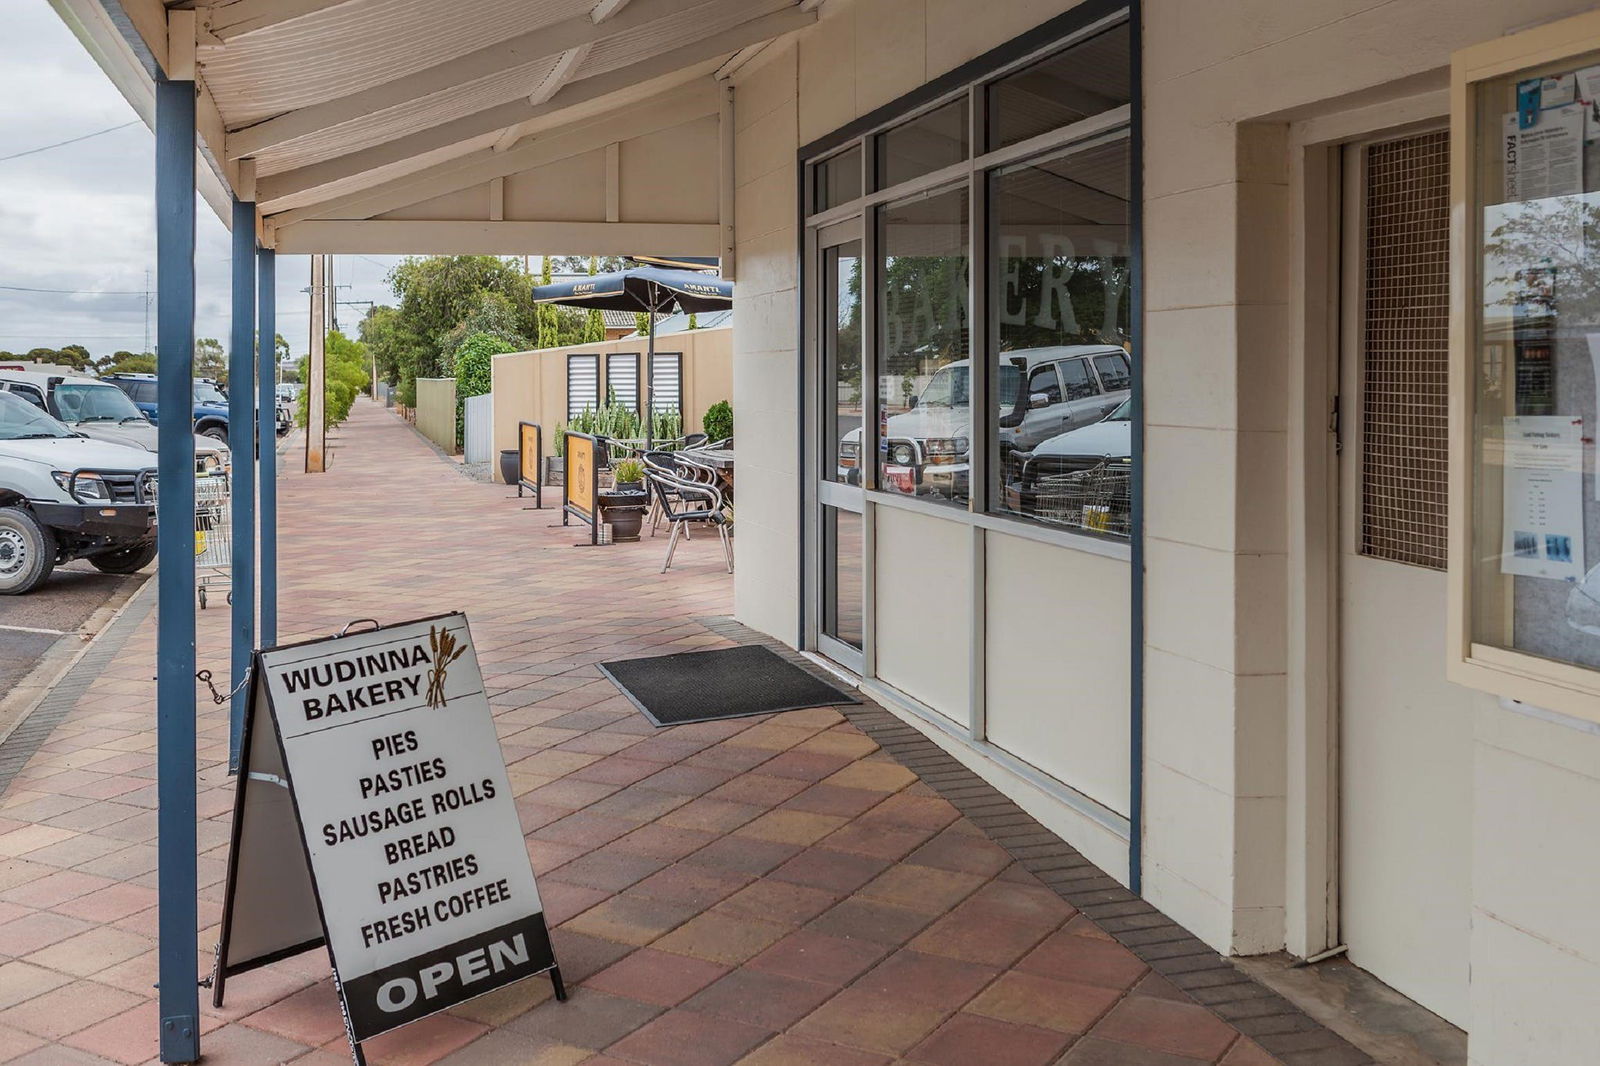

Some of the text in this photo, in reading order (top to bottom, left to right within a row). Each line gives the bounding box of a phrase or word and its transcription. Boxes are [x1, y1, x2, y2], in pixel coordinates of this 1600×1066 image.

[280, 644, 432, 694] WUDINNA
[302, 674, 422, 721] BAKERY
[371, 730, 419, 761] PIES
[358, 757, 447, 799] PASTIES
[322, 778, 496, 847] SAUSAGE ROLLS
[383, 826, 456, 866] BREAD
[377, 853, 479, 905] PASTRIES
[360, 878, 512, 949] FRESH COFFEE
[376, 933, 530, 1013] OPEN
